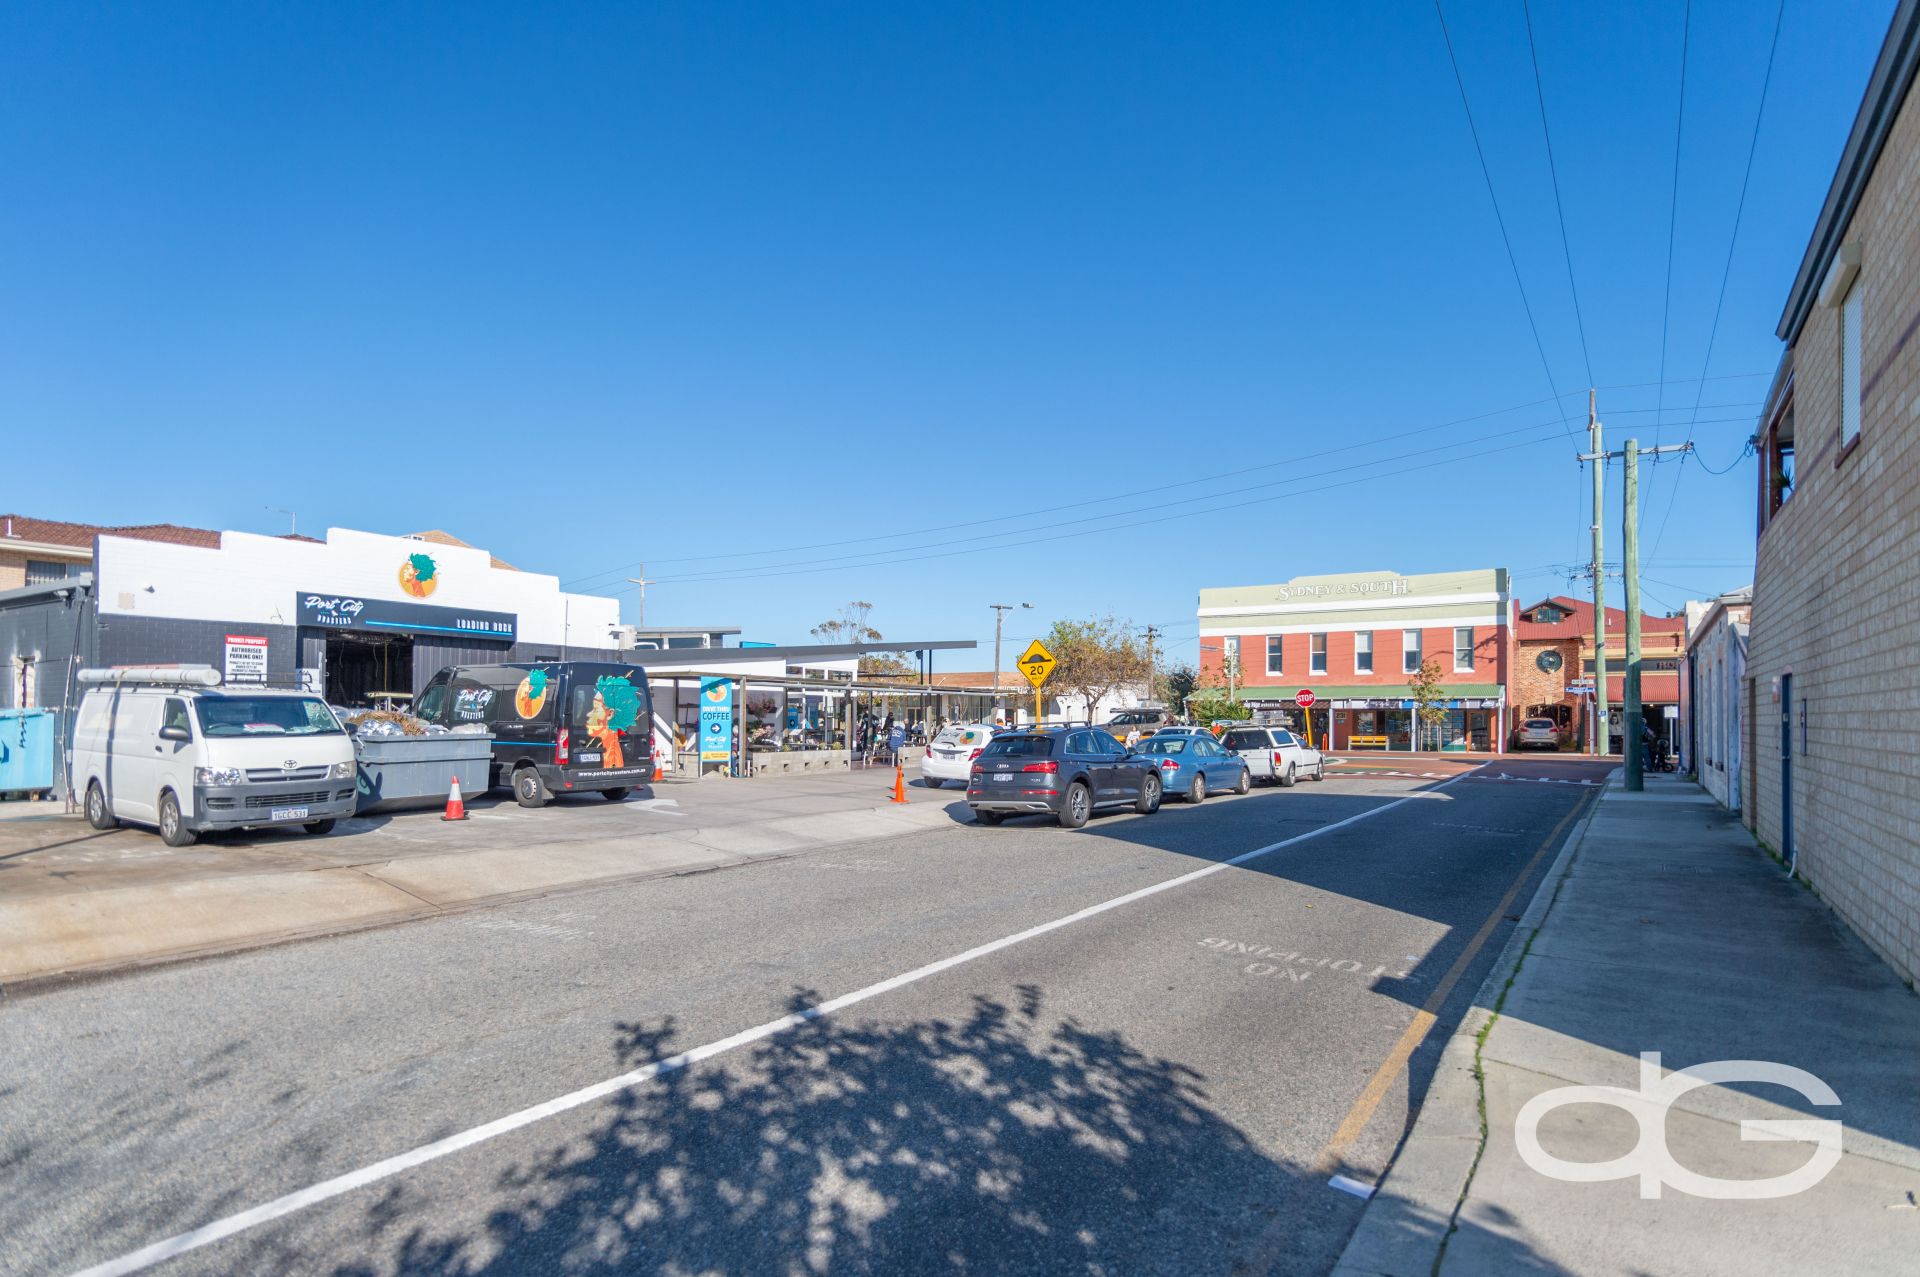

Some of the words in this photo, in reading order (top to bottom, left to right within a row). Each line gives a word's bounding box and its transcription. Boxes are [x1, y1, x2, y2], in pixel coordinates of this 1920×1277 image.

[1279, 585, 1330, 601] SYDNEY
[1336, 584, 1346, 594] &
[1350, 579, 1408, 595] SOUTH
[304, 596, 340, 609] Port
[340, 599, 364, 616] City
[456, 618, 489, 631] LOADING
[493, 622, 512, 632] DOCK
[1030, 665, 1044, 675] 20
[458, 689, 479, 701] Port
[478, 689, 493, 706] City
[1296, 693, 1314, 703] STOP
[702, 712, 730, 720] COFFEE
